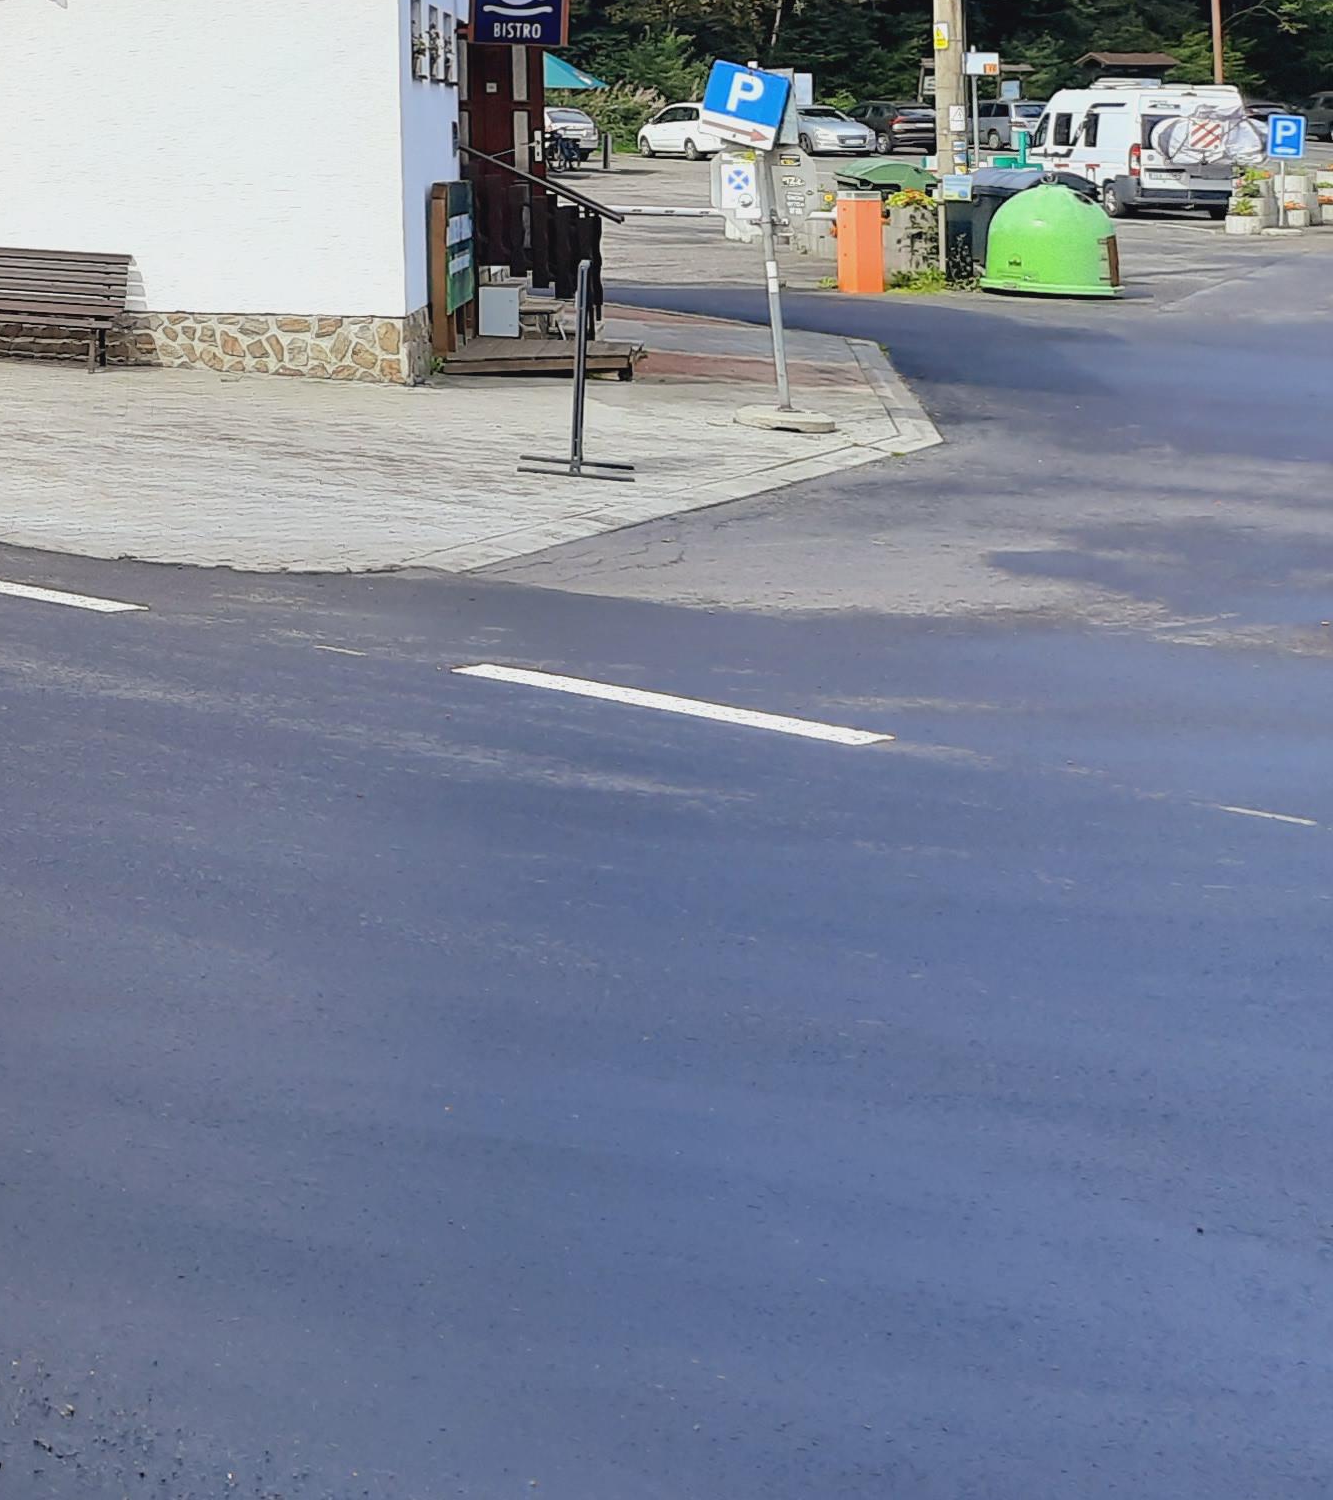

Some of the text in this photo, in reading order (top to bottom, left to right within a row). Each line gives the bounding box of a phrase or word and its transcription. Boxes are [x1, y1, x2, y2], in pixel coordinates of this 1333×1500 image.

[493, 22, 542, 39] BISTRO
[726, 71, 764, 112] P
[1276, 120, 1297, 145] P
